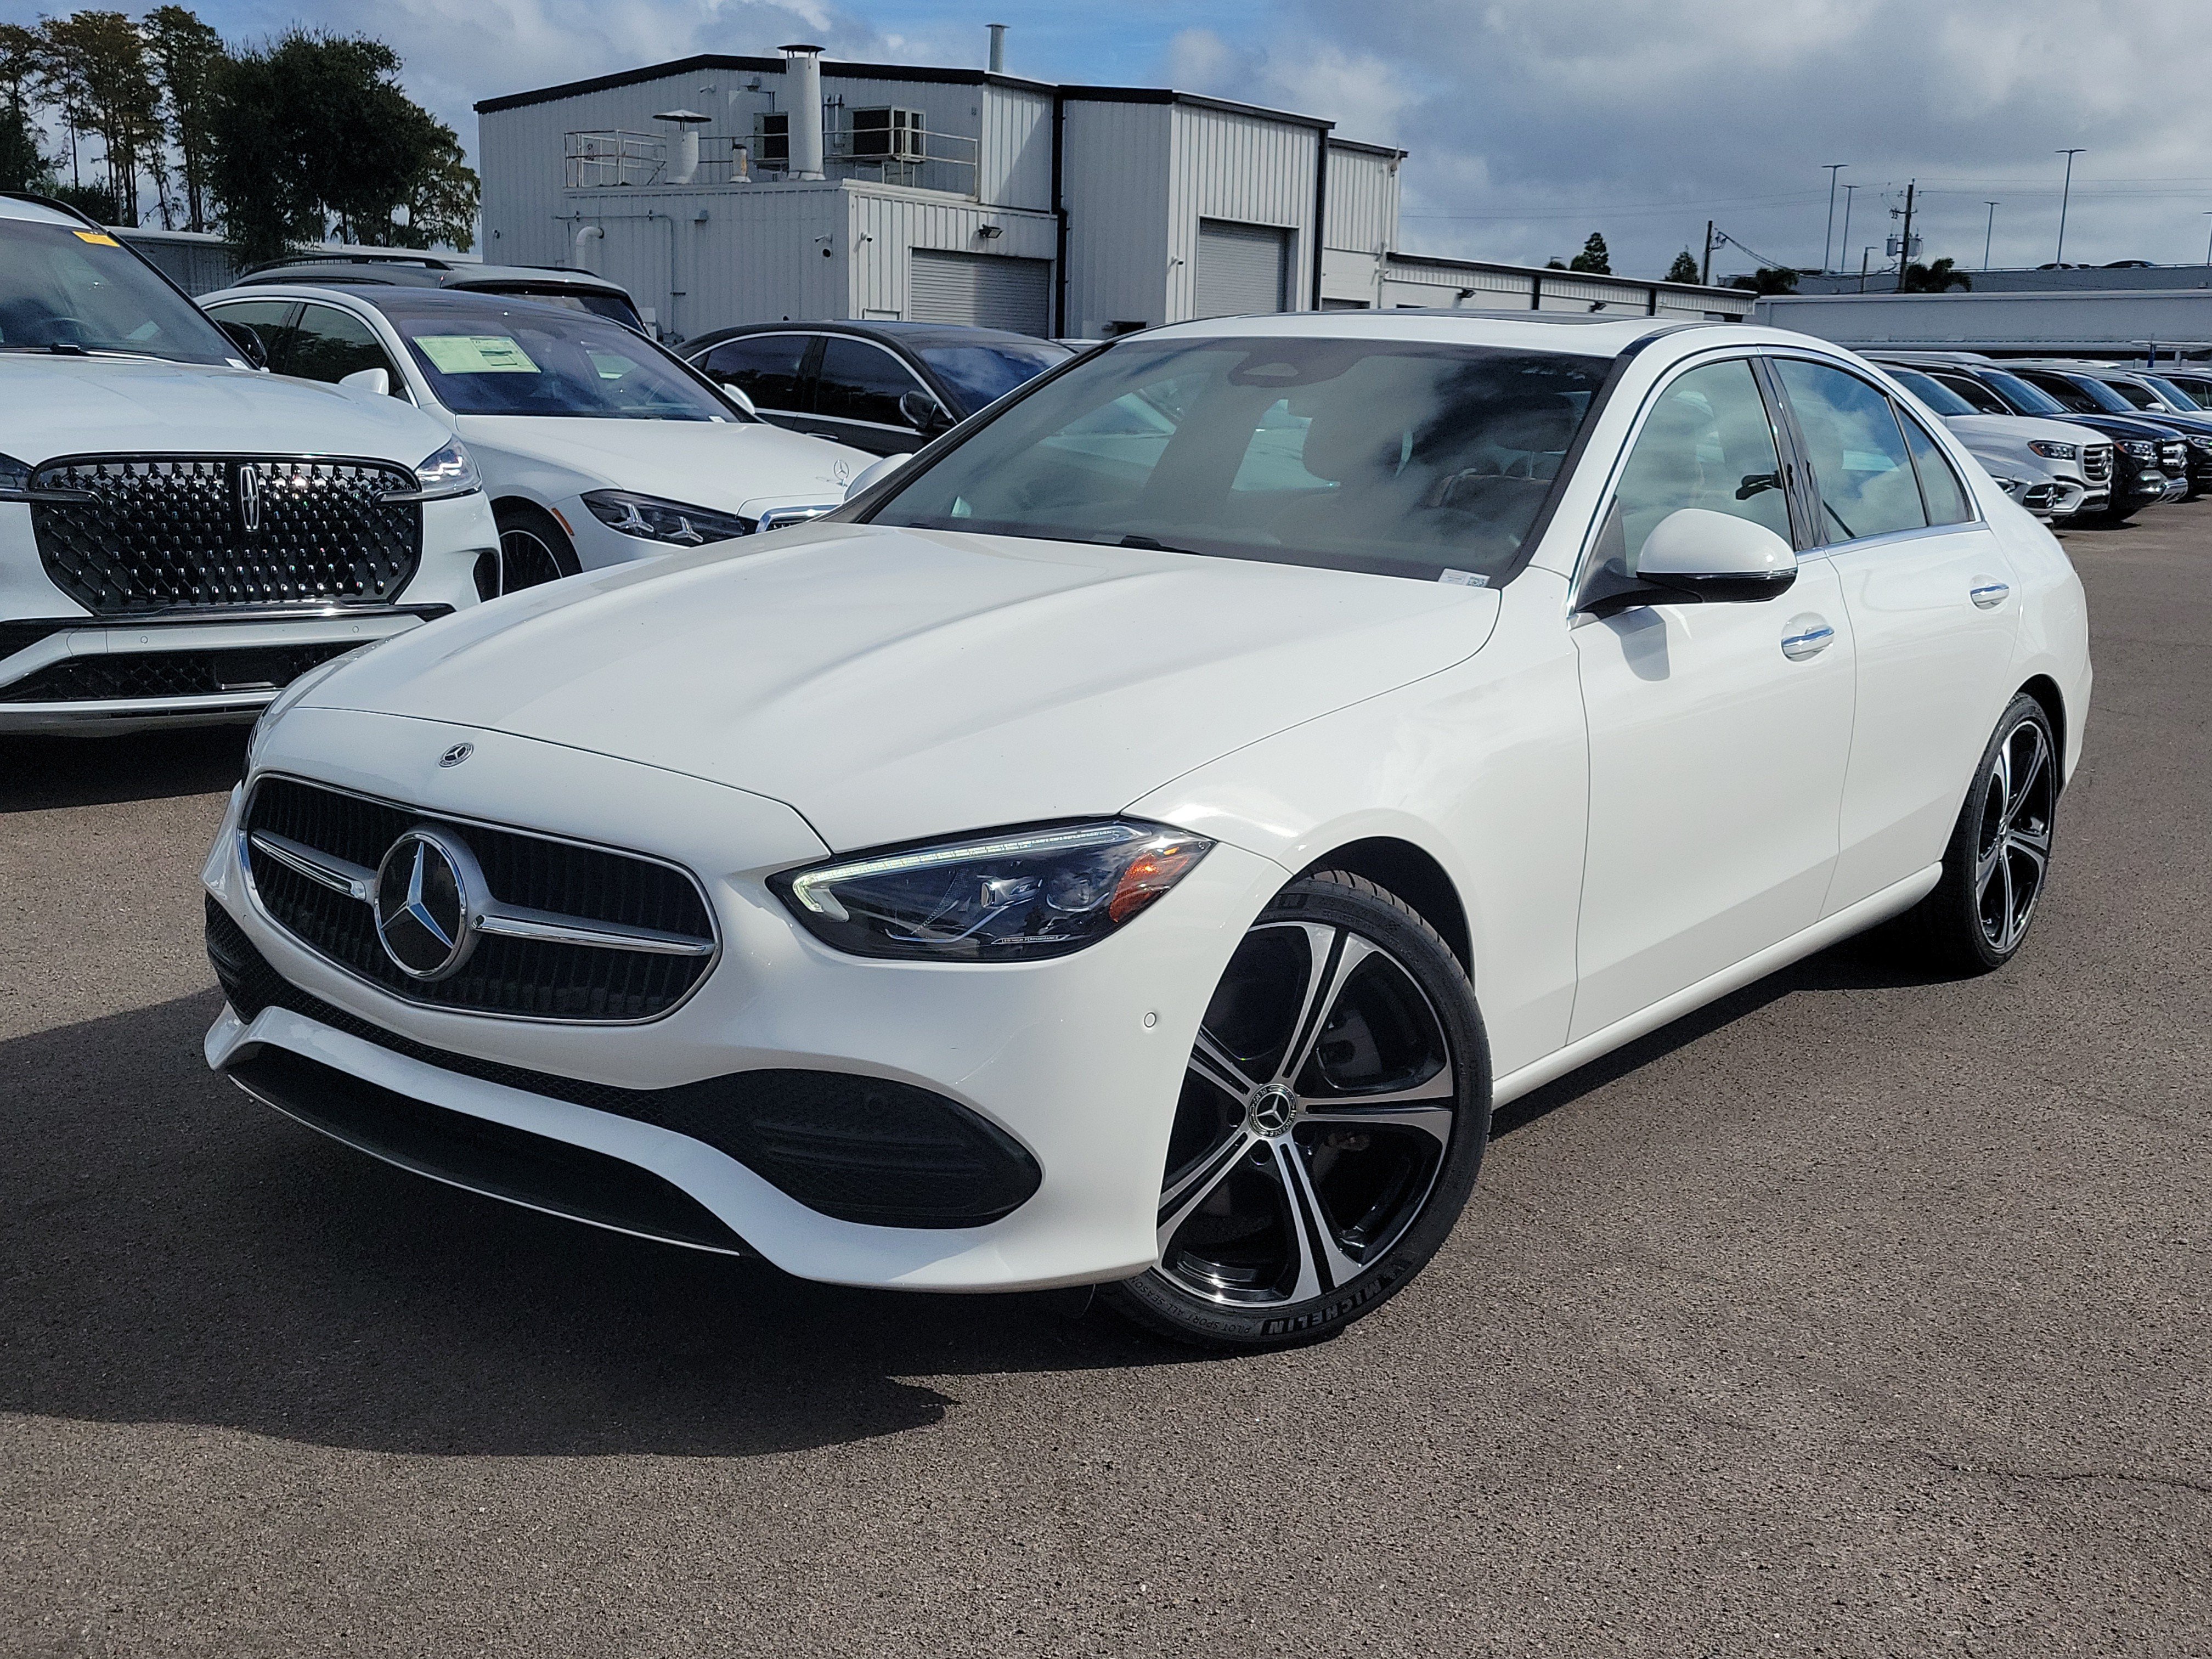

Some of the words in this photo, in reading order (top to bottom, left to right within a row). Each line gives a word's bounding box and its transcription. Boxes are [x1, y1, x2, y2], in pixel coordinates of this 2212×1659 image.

[1167, 1303, 1184, 1316] ALL
[1268, 1279, 1382, 1334] MICHELIN
[1187, 1314, 1220, 1329] SPORT
[1221, 1323, 1251, 1334] PILOT
